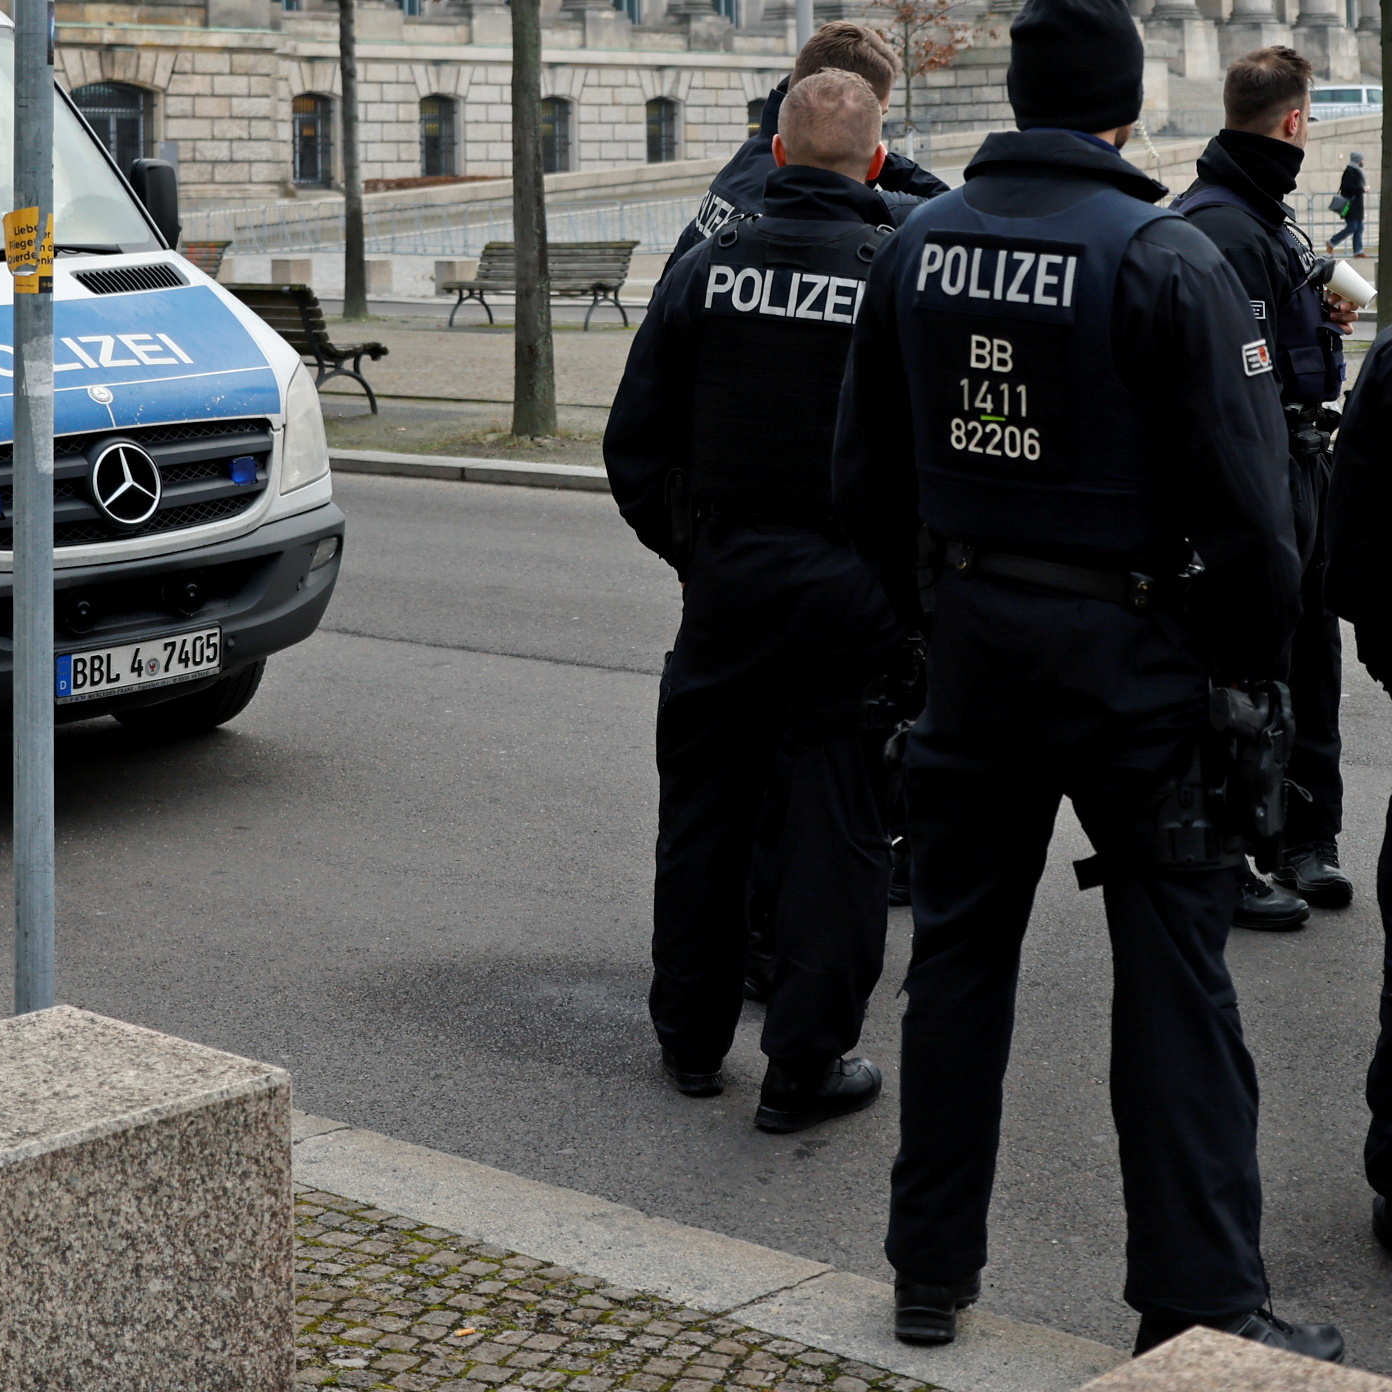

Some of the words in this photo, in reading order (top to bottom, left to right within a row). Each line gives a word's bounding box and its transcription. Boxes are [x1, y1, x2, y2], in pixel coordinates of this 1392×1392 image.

[704, 264, 867, 325] POLIZEI
[917, 243, 1077, 307] POLIZEI
[970, 334, 1013, 373] BB
[960, 378, 1027, 417] 1411
[950, 417, 1041, 461] 82206
[73, 653, 121, 690] BBL
[130, 647, 144, 678] 4
[163, 632, 218, 672] 7405
[60, 680, 67, 690] D
